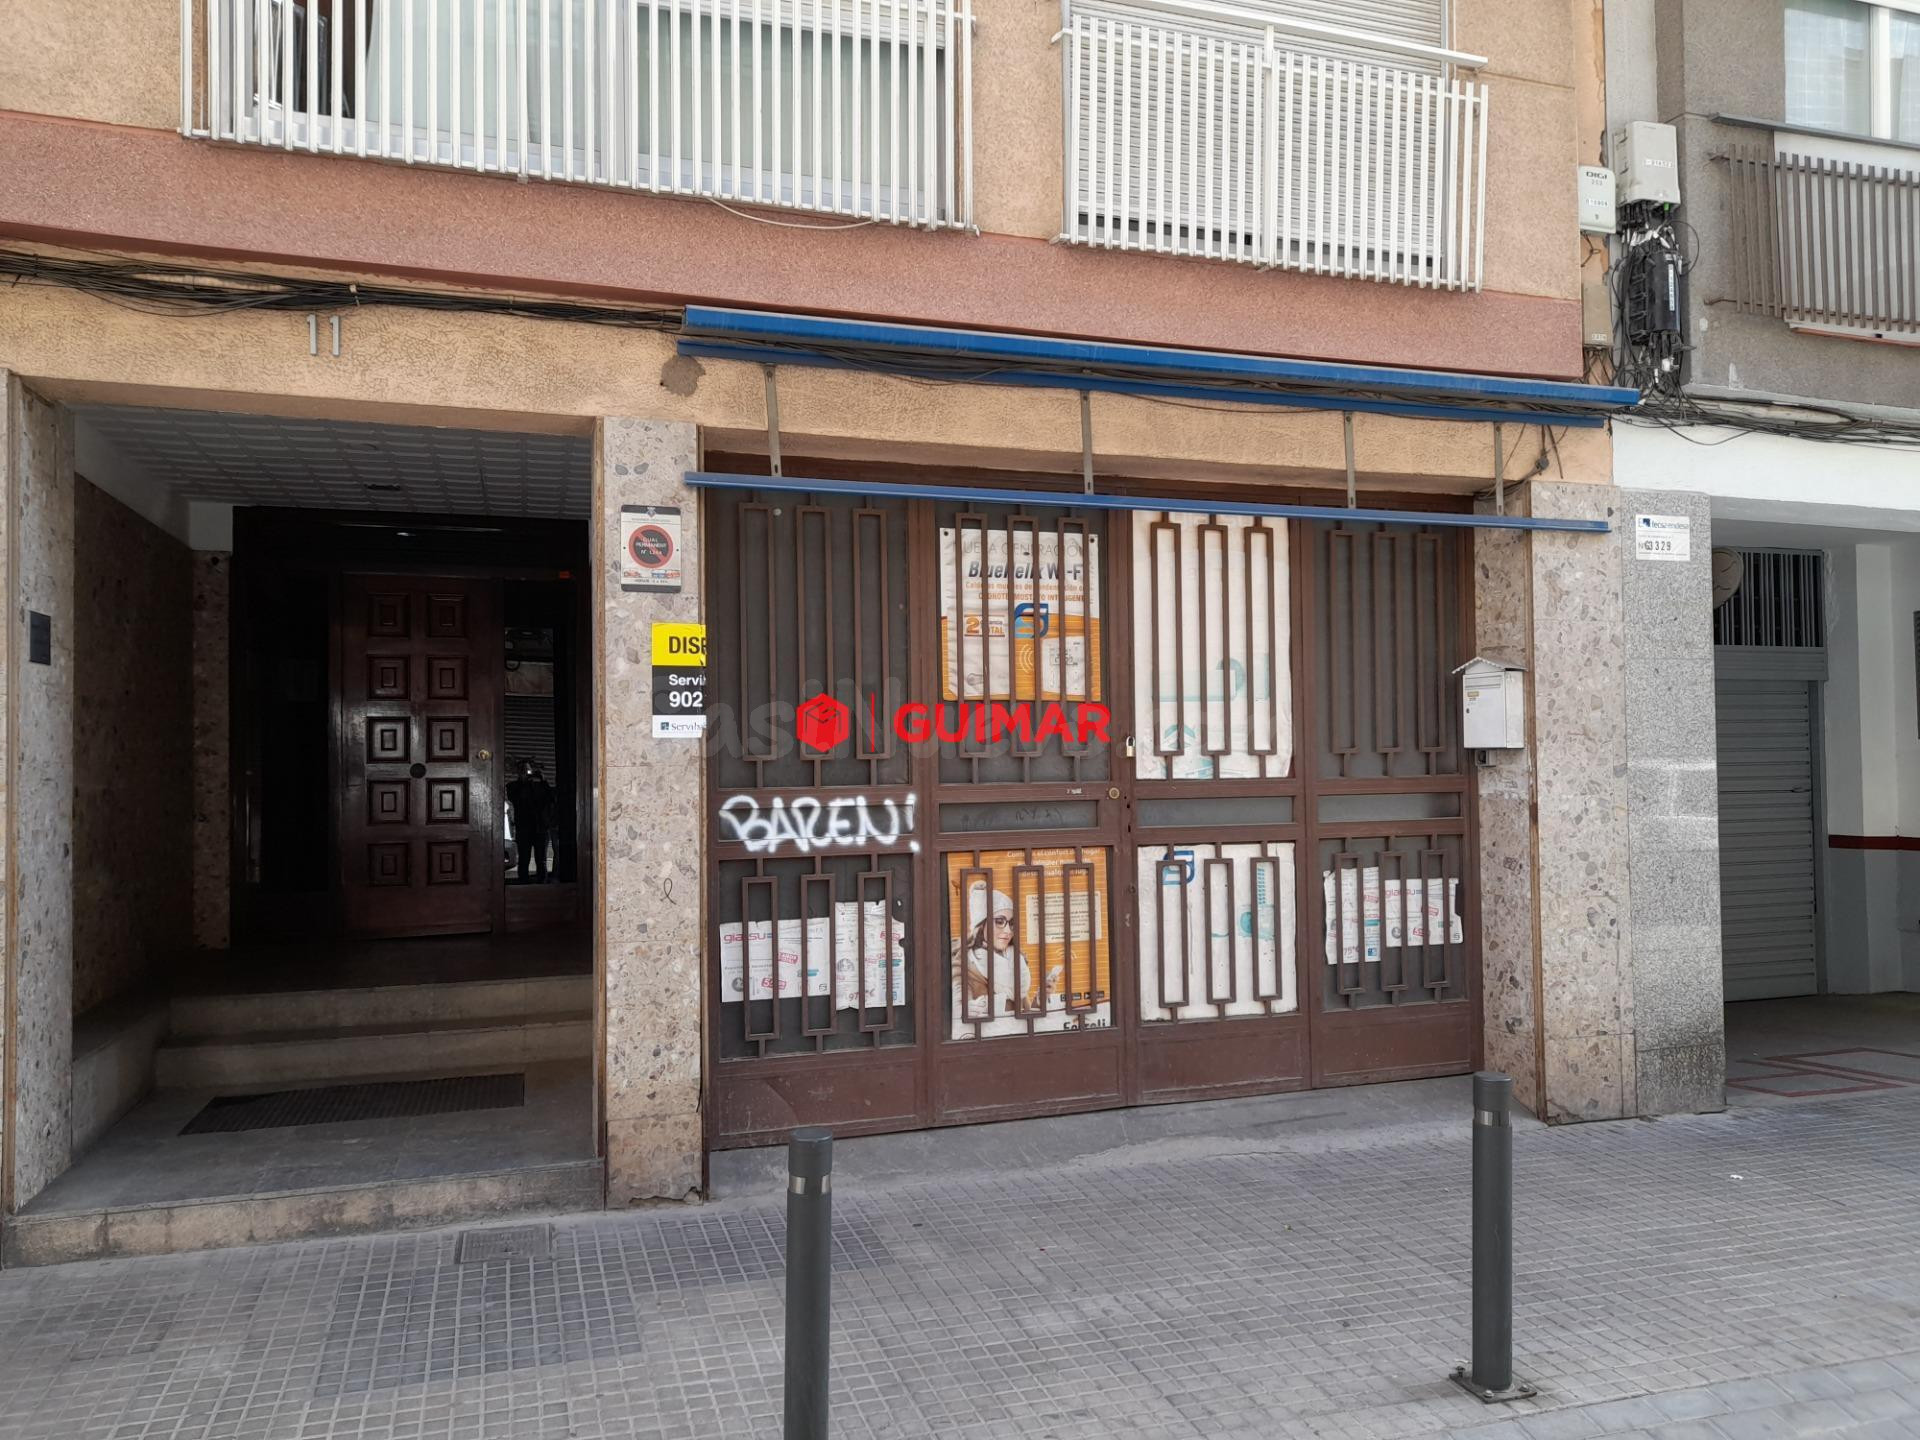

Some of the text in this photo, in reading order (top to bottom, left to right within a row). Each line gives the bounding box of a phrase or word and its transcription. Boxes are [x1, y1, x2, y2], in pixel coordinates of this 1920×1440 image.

[1585, 171, 1608, 180] DIGI
[306, 313, 340, 356] 11
[668, 691, 703, 708] 902
[723, 932, 766, 944] giasu
[1063, 1018, 1106, 1030] Feroli
